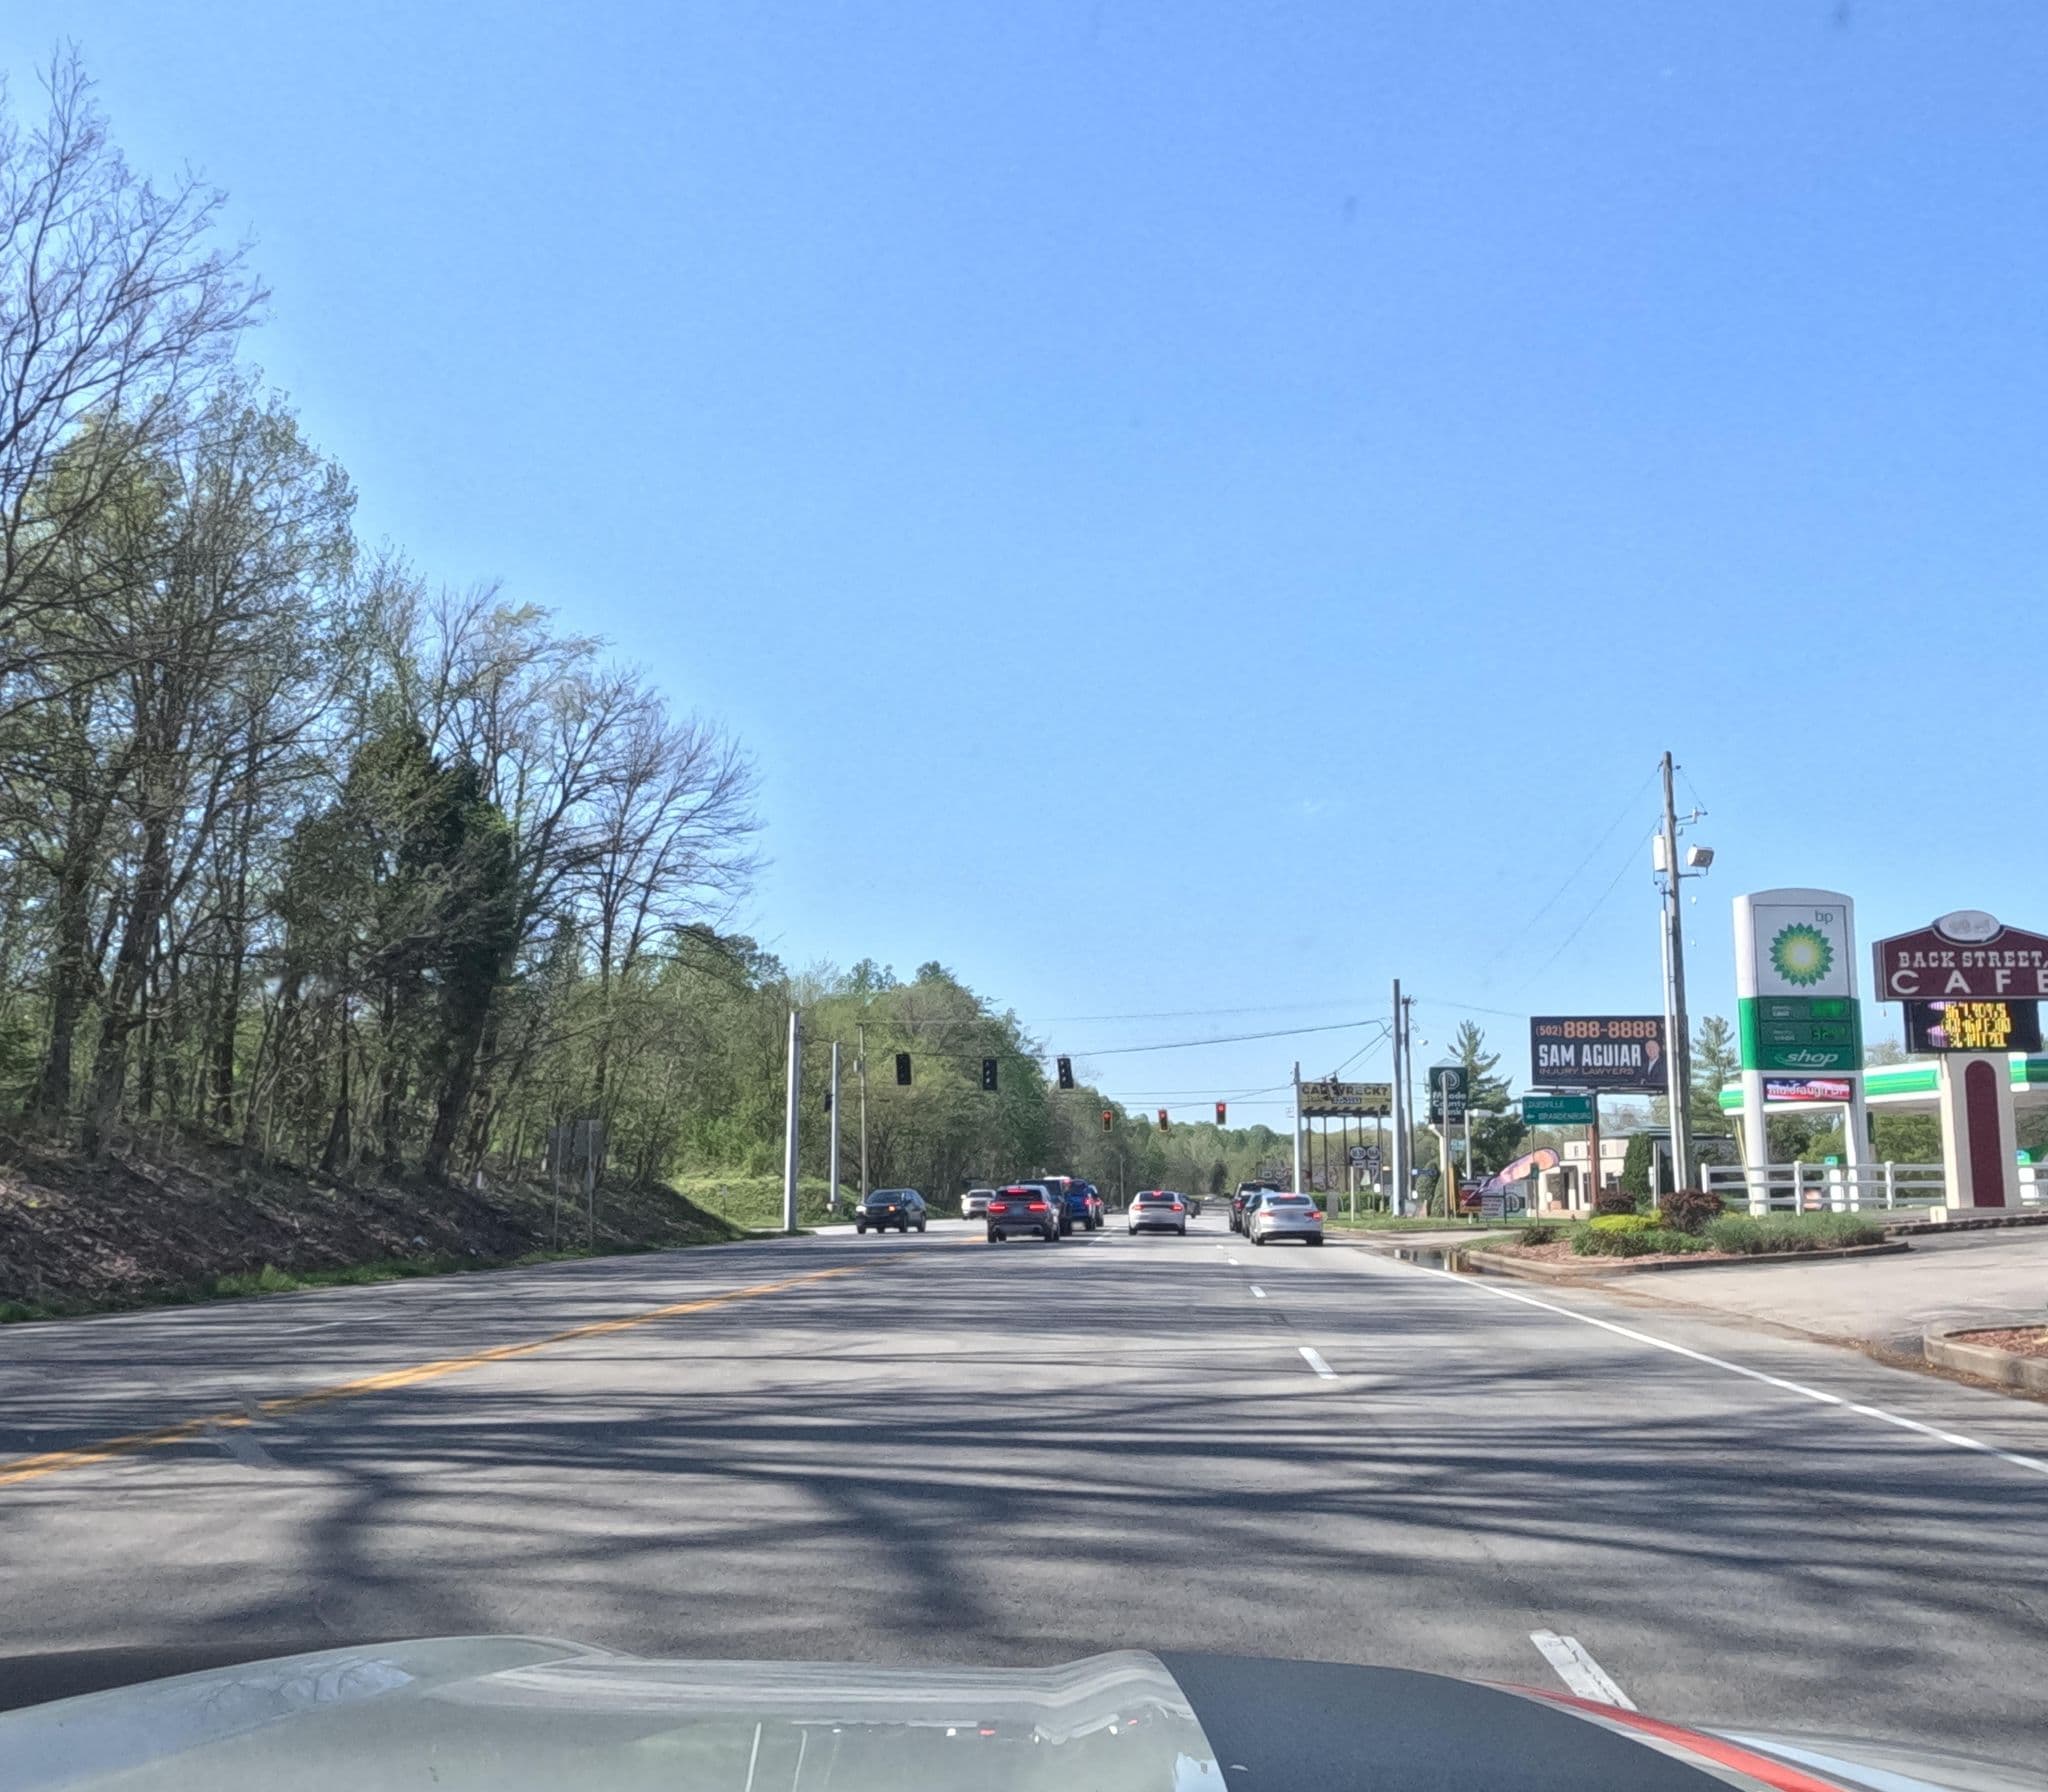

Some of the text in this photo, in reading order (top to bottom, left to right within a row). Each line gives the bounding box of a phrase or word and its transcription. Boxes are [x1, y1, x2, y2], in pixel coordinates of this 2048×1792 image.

[1815, 910, 1834, 925] bp
[1898, 951, 1956, 968] BACK
[1961, 951, 2042, 968] STREET
[1890, 969, 2048, 994] CAFE
[1535, 1020, 1657, 1039] (502) 888-8888
[1538, 1044, 1642, 1067] SAM AGUIAR
[1785, 1049, 1836, 1065] shop
[1539, 1067, 1634, 1076] INJURY LAWYERS
[1433, 1091, 1467, 1100] Made
[1437, 1107, 1462, 1116] Bnk
